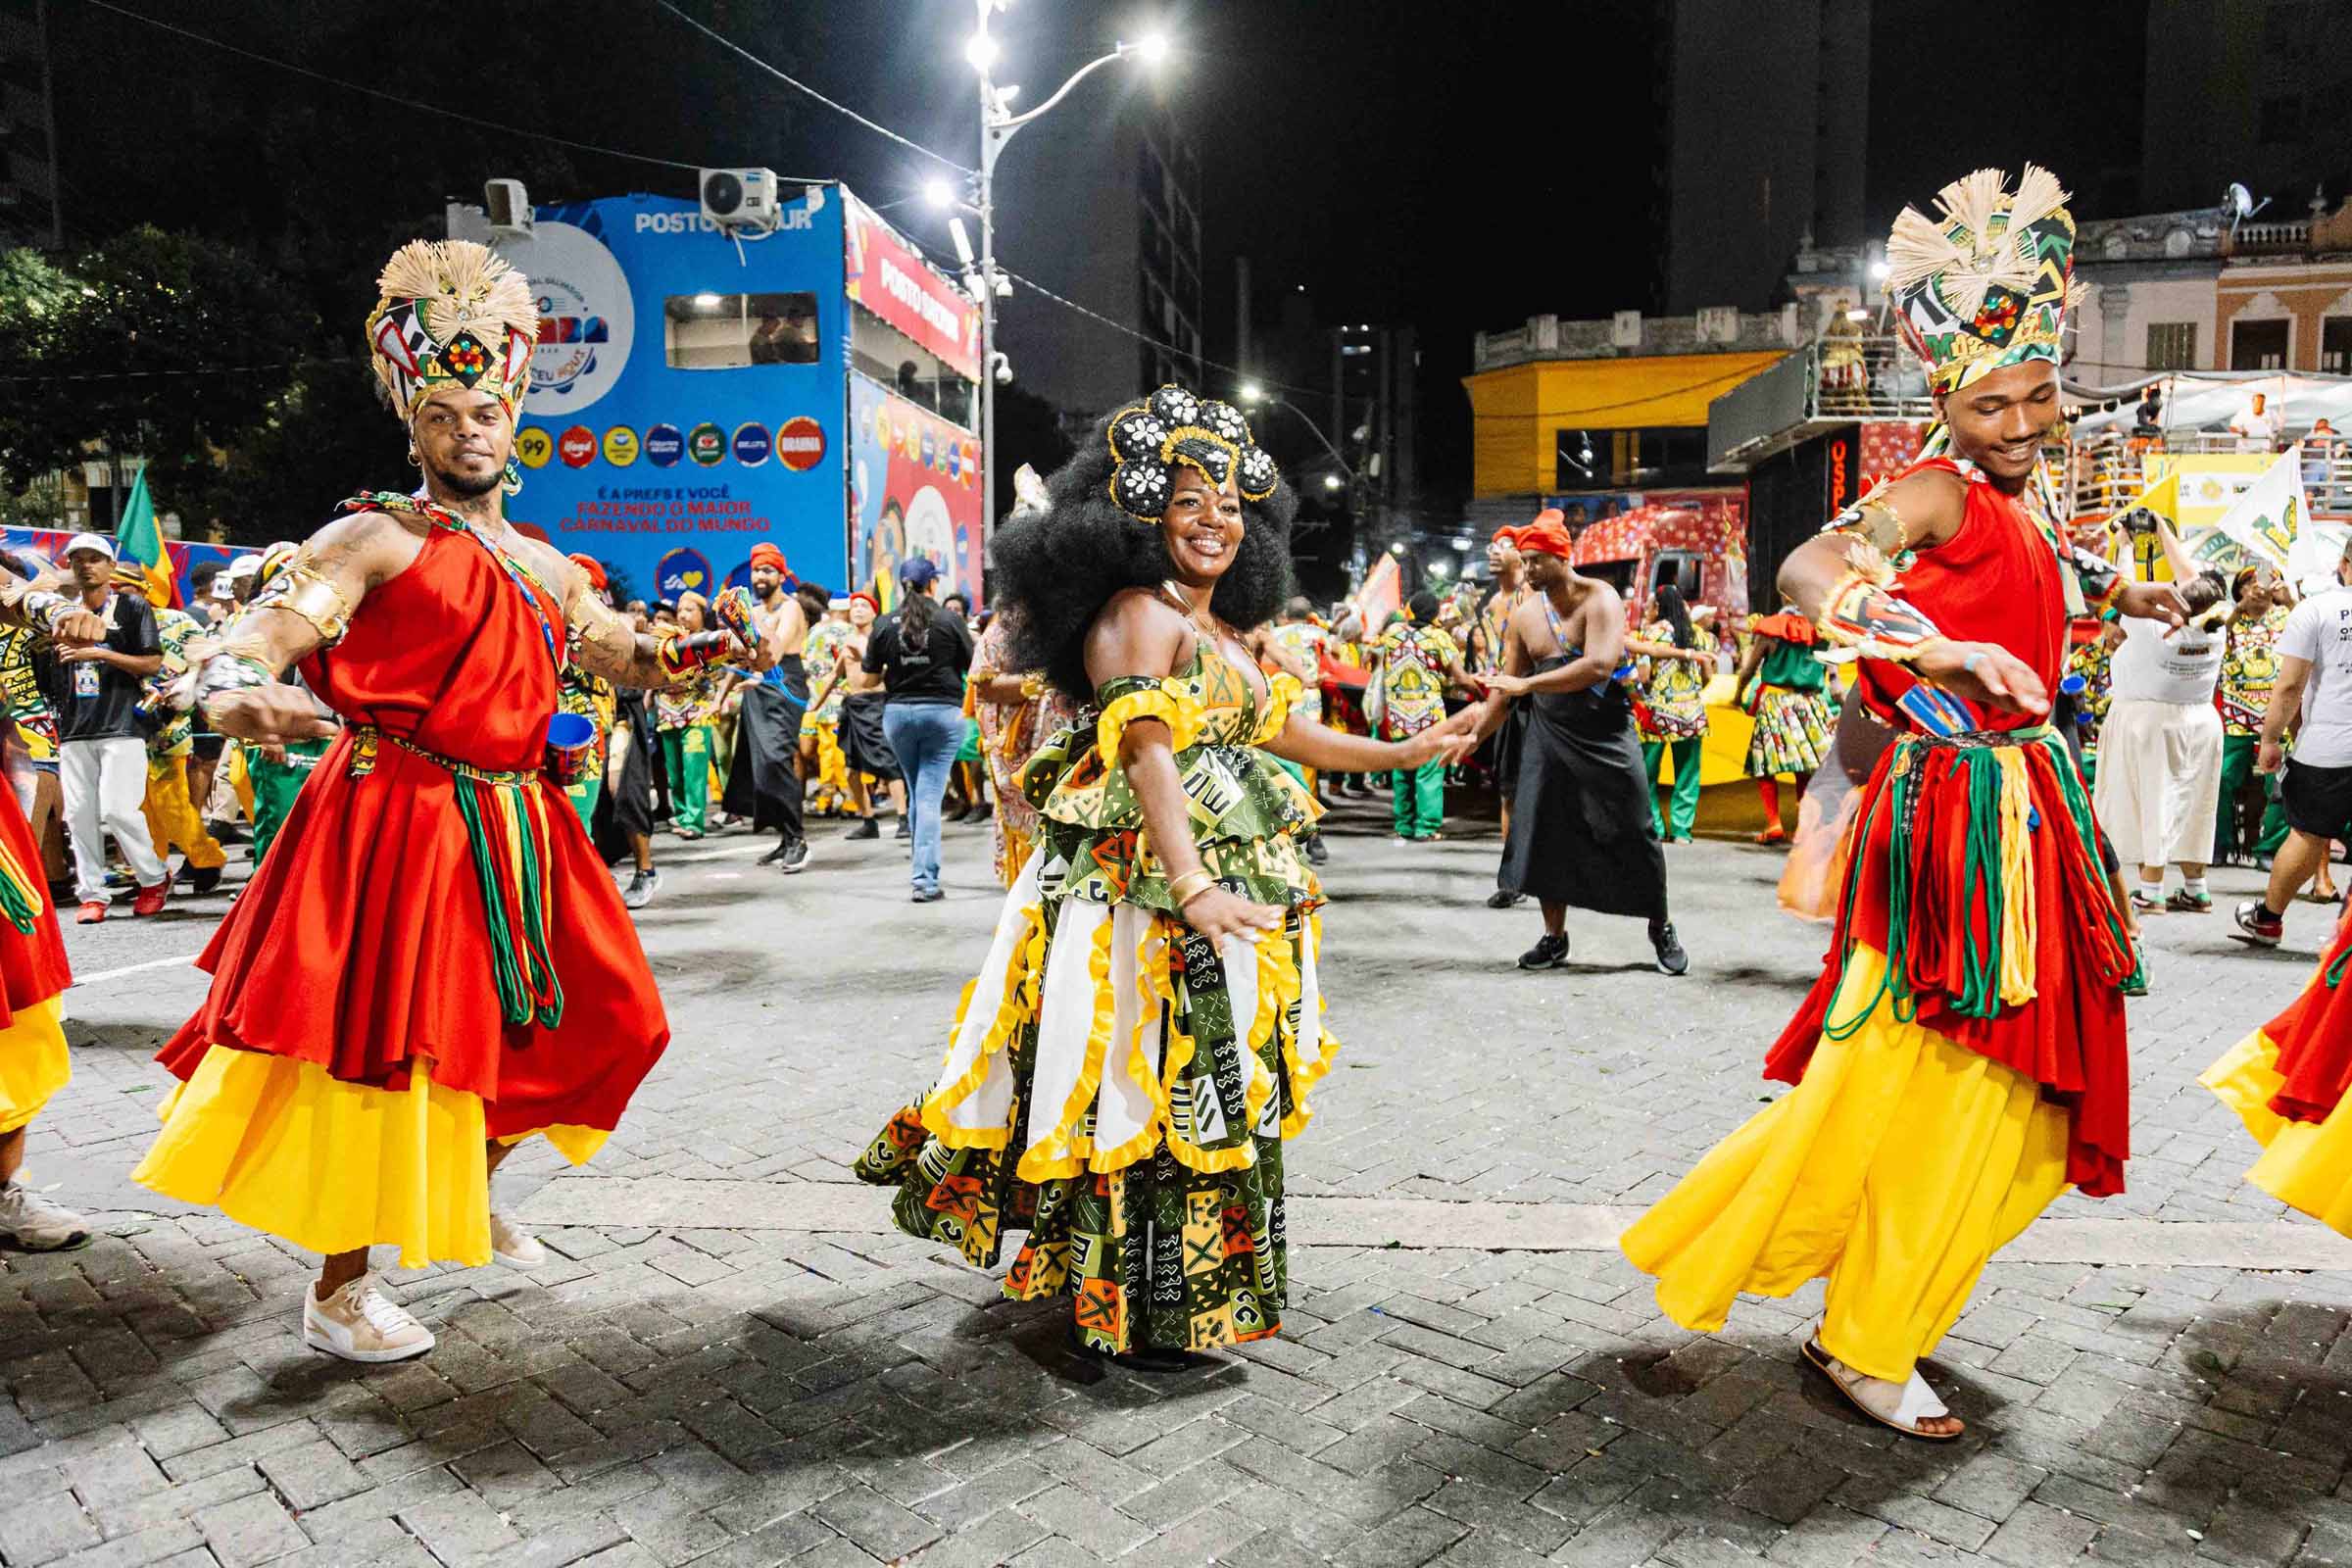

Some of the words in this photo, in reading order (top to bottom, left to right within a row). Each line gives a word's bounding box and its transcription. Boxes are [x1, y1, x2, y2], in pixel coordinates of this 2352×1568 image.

[635, 213, 718, 233] POSTO
[522, 438, 545, 456] 99
[597, 485, 606, 500] É
[611, 489, 620, 500] A
[675, 488, 684, 500] E
[687, 483, 730, 500] VOCÊ
[576, 501, 665, 516] FAZENDO
[669, 501, 683, 516] O
[687, 501, 752, 515] MAIOR
[559, 517, 662, 533] CARNAVAL
[665, 517, 693, 533] DO
[698, 516, 772, 532] MUNDO
